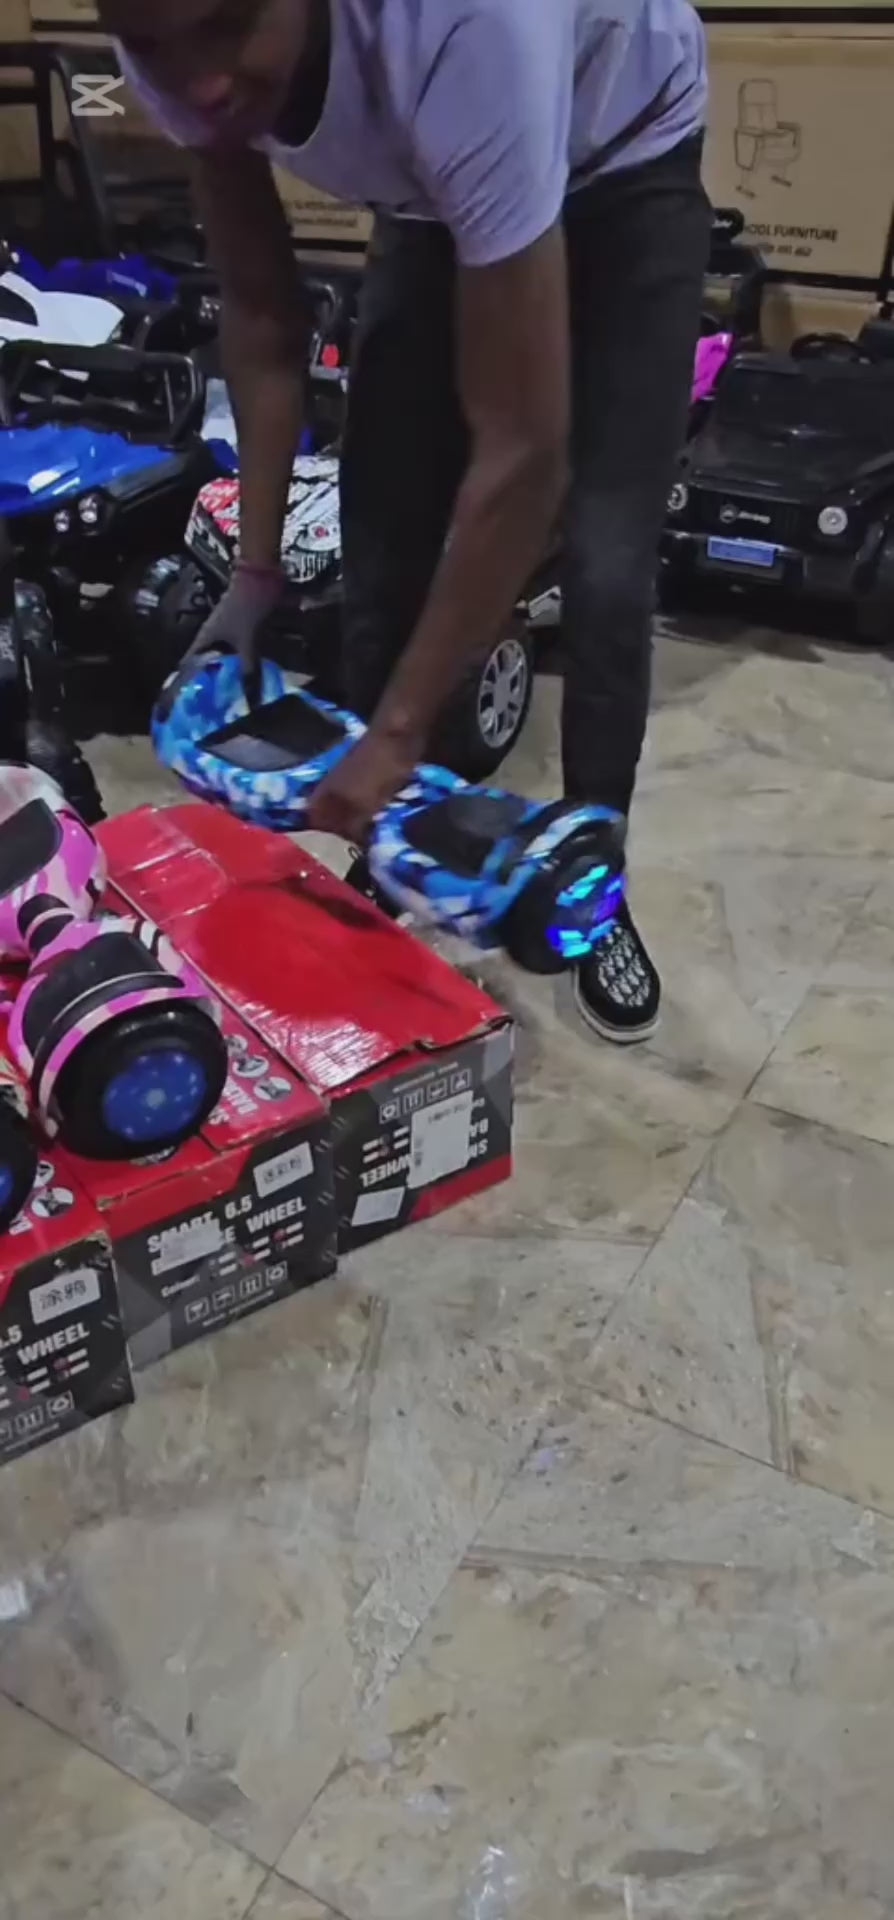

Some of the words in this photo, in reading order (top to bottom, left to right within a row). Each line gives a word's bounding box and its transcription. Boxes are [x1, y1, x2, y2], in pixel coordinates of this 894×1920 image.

[225, 1195, 252, 1219] 6.5
[246, 1197, 306, 1233] WHEEL
[16, 1321, 90, 1365] WHEEL
